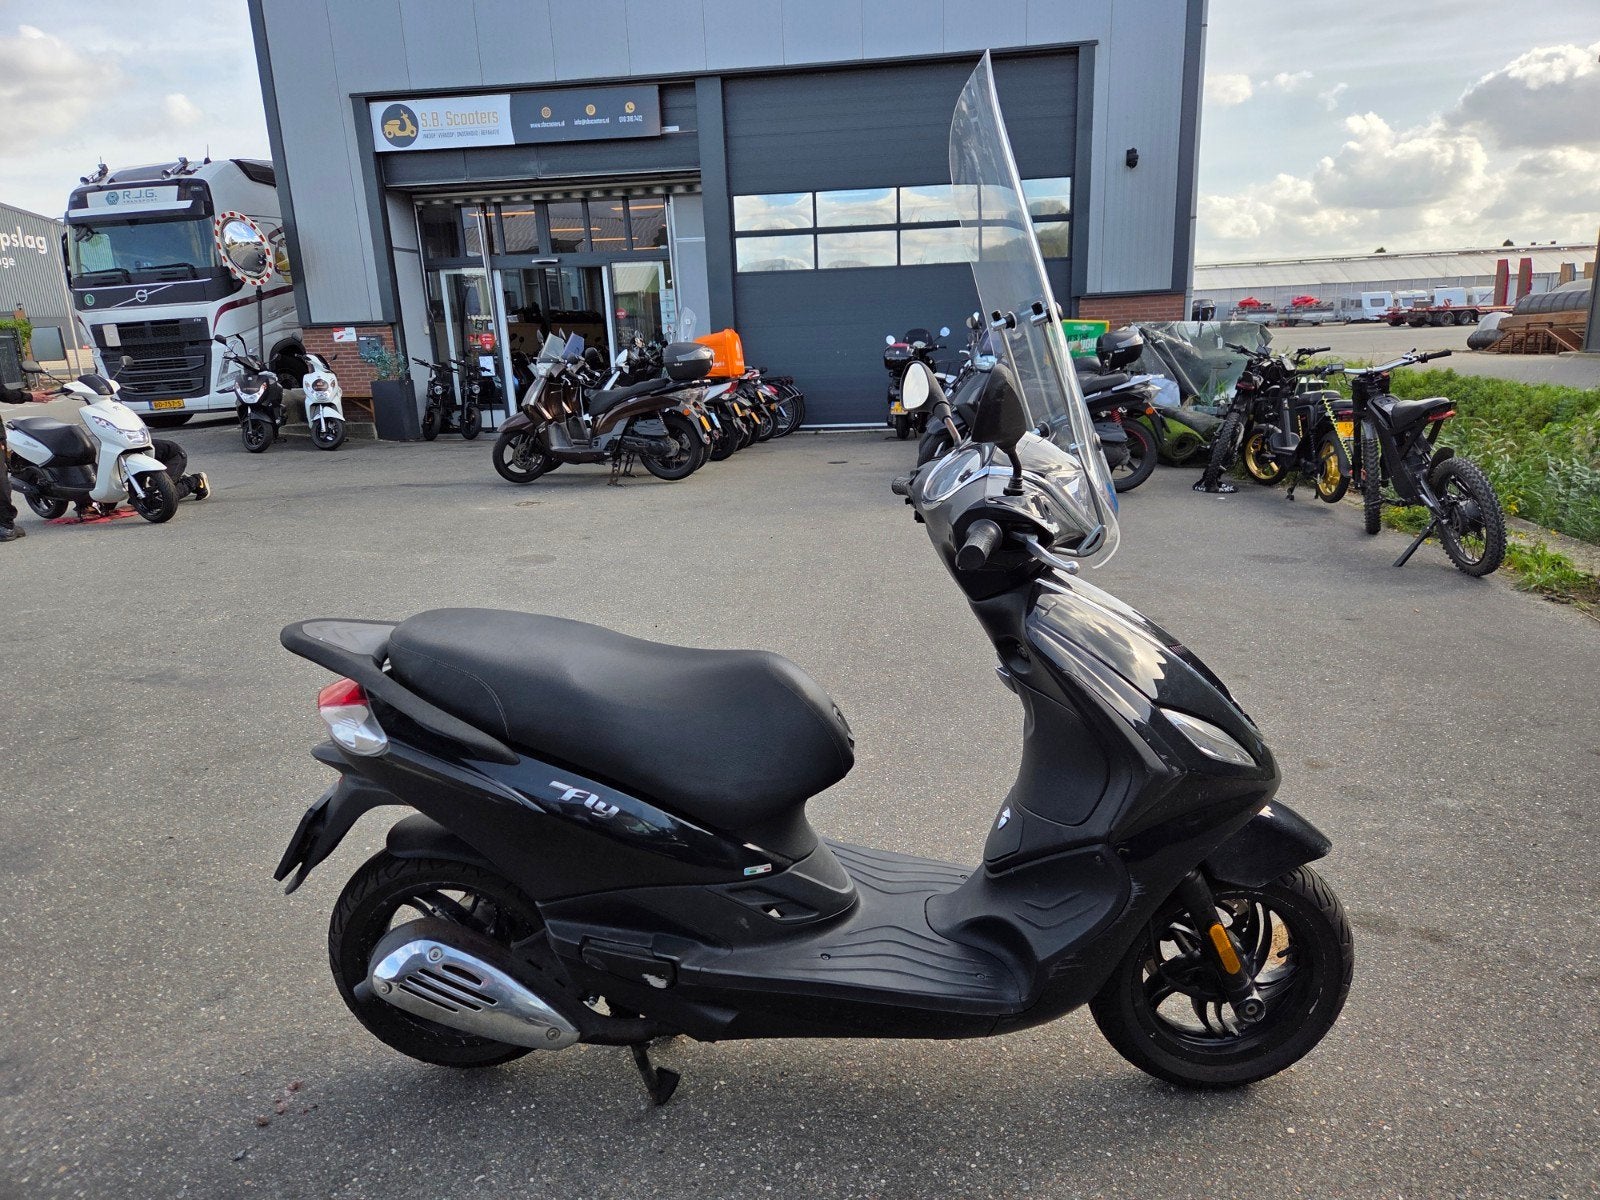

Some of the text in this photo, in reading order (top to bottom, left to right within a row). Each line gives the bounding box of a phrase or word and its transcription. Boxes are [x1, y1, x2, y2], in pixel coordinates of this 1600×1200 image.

[420, 110, 499, 127] S.B. Scooters
[549, 780, 620, 818] Fly
